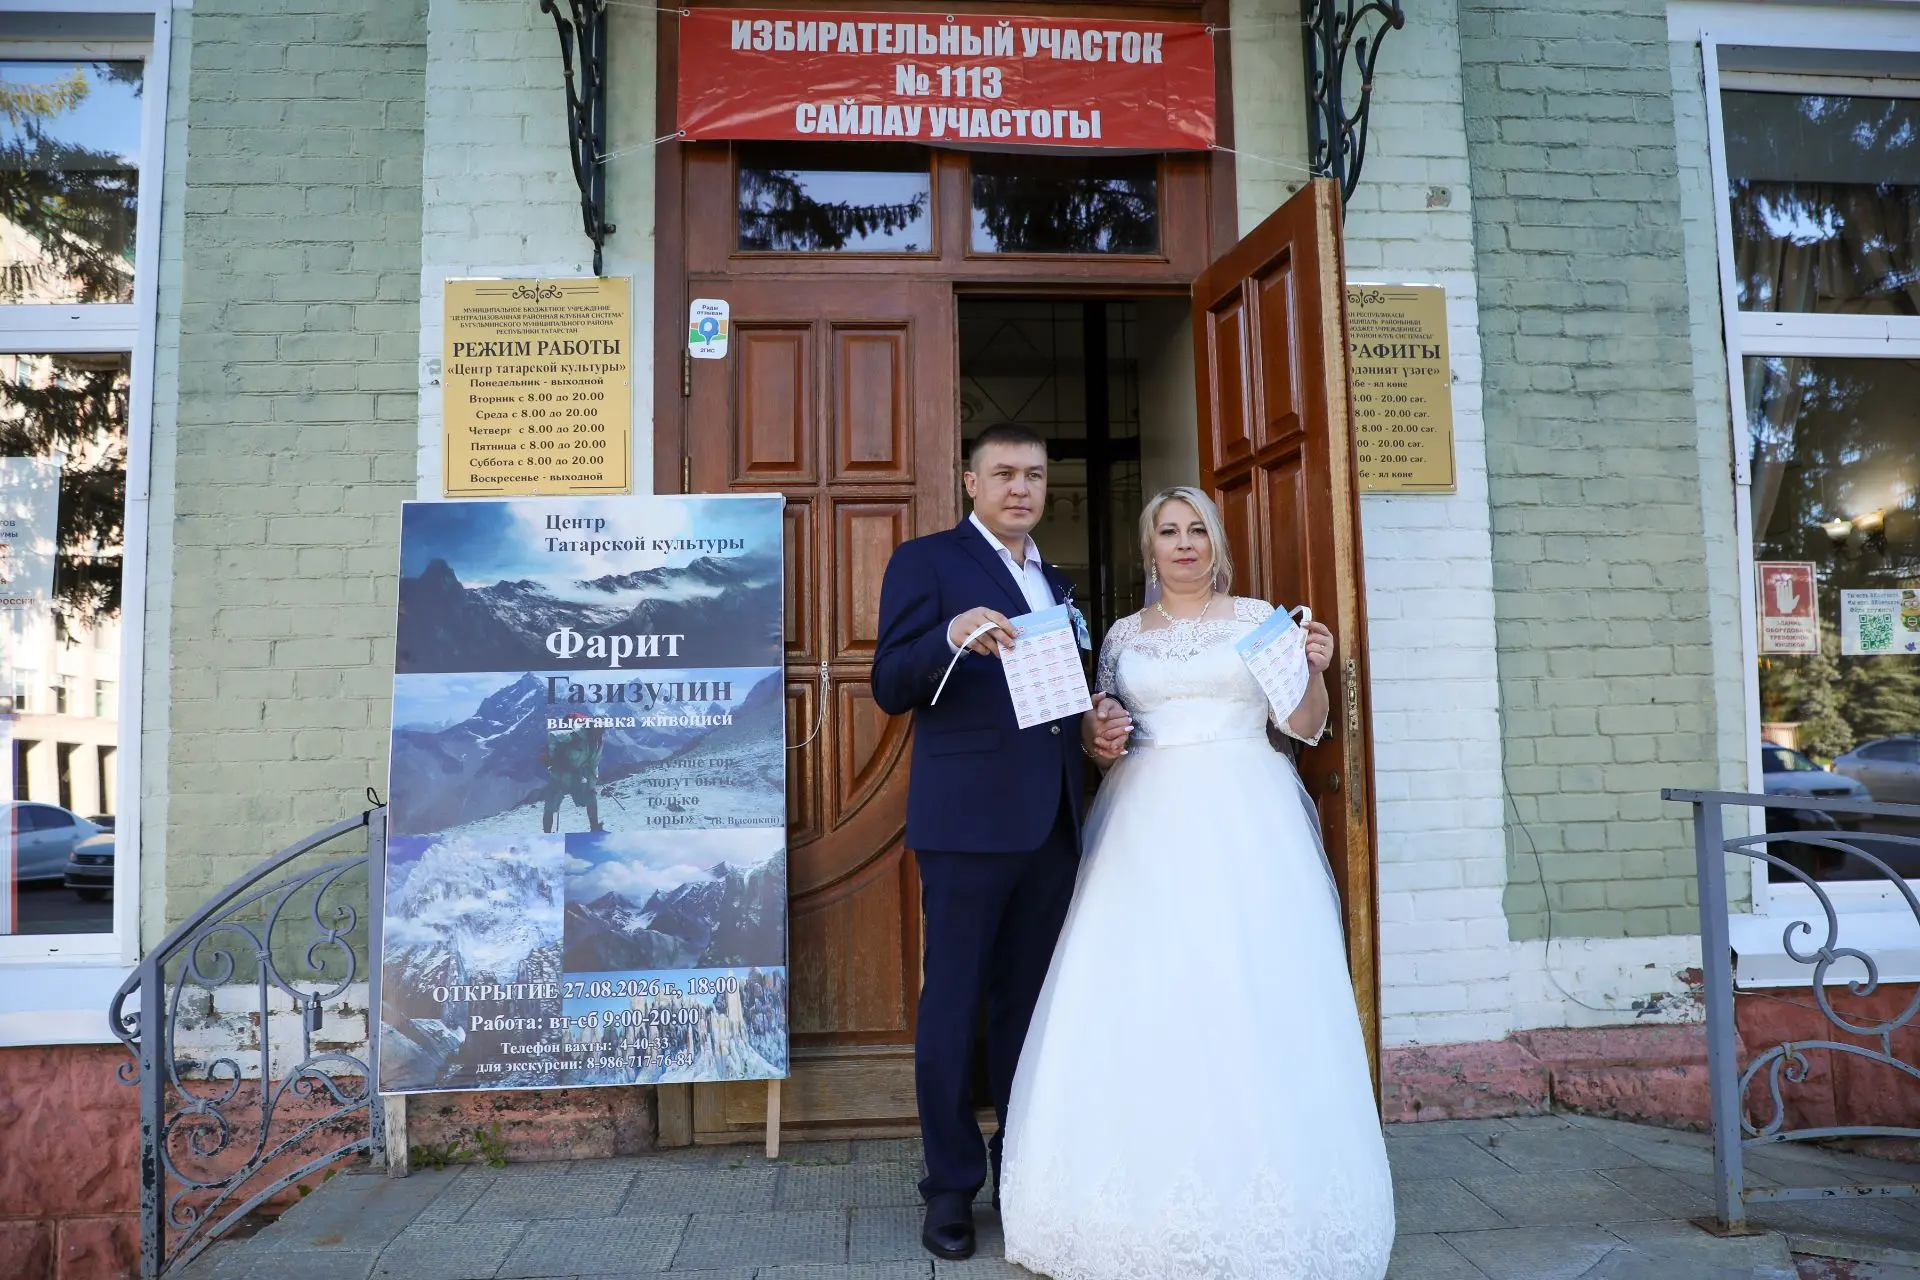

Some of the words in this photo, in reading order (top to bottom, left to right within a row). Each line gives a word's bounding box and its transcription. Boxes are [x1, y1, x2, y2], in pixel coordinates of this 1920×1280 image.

[731, 19, 1014, 57] ИЗБИРАТЕЛЬНЫЙ
[1022, 27, 1164, 64] УЧАСТОК
[896, 64, 929, 96] №
[936, 65, 1002, 99] 1113
[795, 97, 924, 137] САЙЛАУ
[930, 106, 1101, 139] УЧАСТОГЫ
[453, 341, 531, 357] РЕЖИМ
[537, 339, 621, 356] РАБОТЫ
[1350, 343, 1441, 359] РАФИГЫ
[447, 363, 492, 376] «Центр
[496, 361, 557, 376] татарской
[561, 363, 626, 376] культуры»
[470, 378, 540, 388] Понедельник
[551, 377, 604, 386] выходной
[469, 394, 515, 404] Вторник
[527, 393, 553, 402] 8.00
[572, 392, 605, 401] 20.00
[1381, 394, 1407, 403] 20.00
[475, 410, 508, 420] Среда
[520, 409, 546, 418] 8.00
[565, 408, 598, 417] 20.00
[1354, 409, 1376, 418] 8.00
[1384, 409, 1411, 418] 20.00
[468, 426, 512, 436] Четверг
[528, 424, 553, 433] 8.00
[573, 423, 605, 433] 20.00
[1361, 424, 1383, 432] 8.00
[1391, 424, 1418, 433] 20.00
[471, 442, 517, 451] Пятница
[529, 440, 555, 449] 8.00
[574, 439, 606, 449] 20.00
[1357, 439, 1369, 448] 00
[1378, 439, 1405, 448] 20.00
[469, 457, 514, 468] Суббота
[527, 456, 552, 465] 8.00
[571, 455, 604, 465] 20.00
[1359, 454, 1372, 463] 00
[1380, 454, 1407, 463] 20.00
[470, 473, 539, 484] Воскресенье
[549, 472, 603, 481] выходной
[1359, 470, 1370, 478] бе
[545, 514, 606, 533] Центр
[544, 536, 646, 555] Татарской
[652, 537, 745, 554] культуры
[545, 626, 685, 668] Фарит
[544, 676, 733, 711] Газизулин
[547, 715, 636, 731] выставка
[640, 712, 733, 729] живописи
[709, 758, 733, 770] гор
[648, 777, 694, 791] могут
[646, 796, 700, 807] только
[646, 815, 695, 828] горы»
[728, 816, 780, 826] Высоцкий)
[433, 983, 558, 1002] ОТКРЫТИЕ
[563, 979, 660, 998] 27.08.2026
[664, 982, 683, 998] г.,
[688, 977, 738, 995] 18:00
[470, 1014, 543, 1032] Работа:
[549, 1011, 598, 1029] вт-сб
[603, 1008, 699, 1028] 9:00-20:00
[500, 1041, 560, 1056] Телефон
[565, 1041, 612, 1052] вахты:
[620, 1037, 669, 1050] 4-40-33
[476, 1063, 502, 1074] для
[505, 1060, 583, 1074] экскурсии:
[586, 1053, 694, 1069] 8-986-717-76-84
